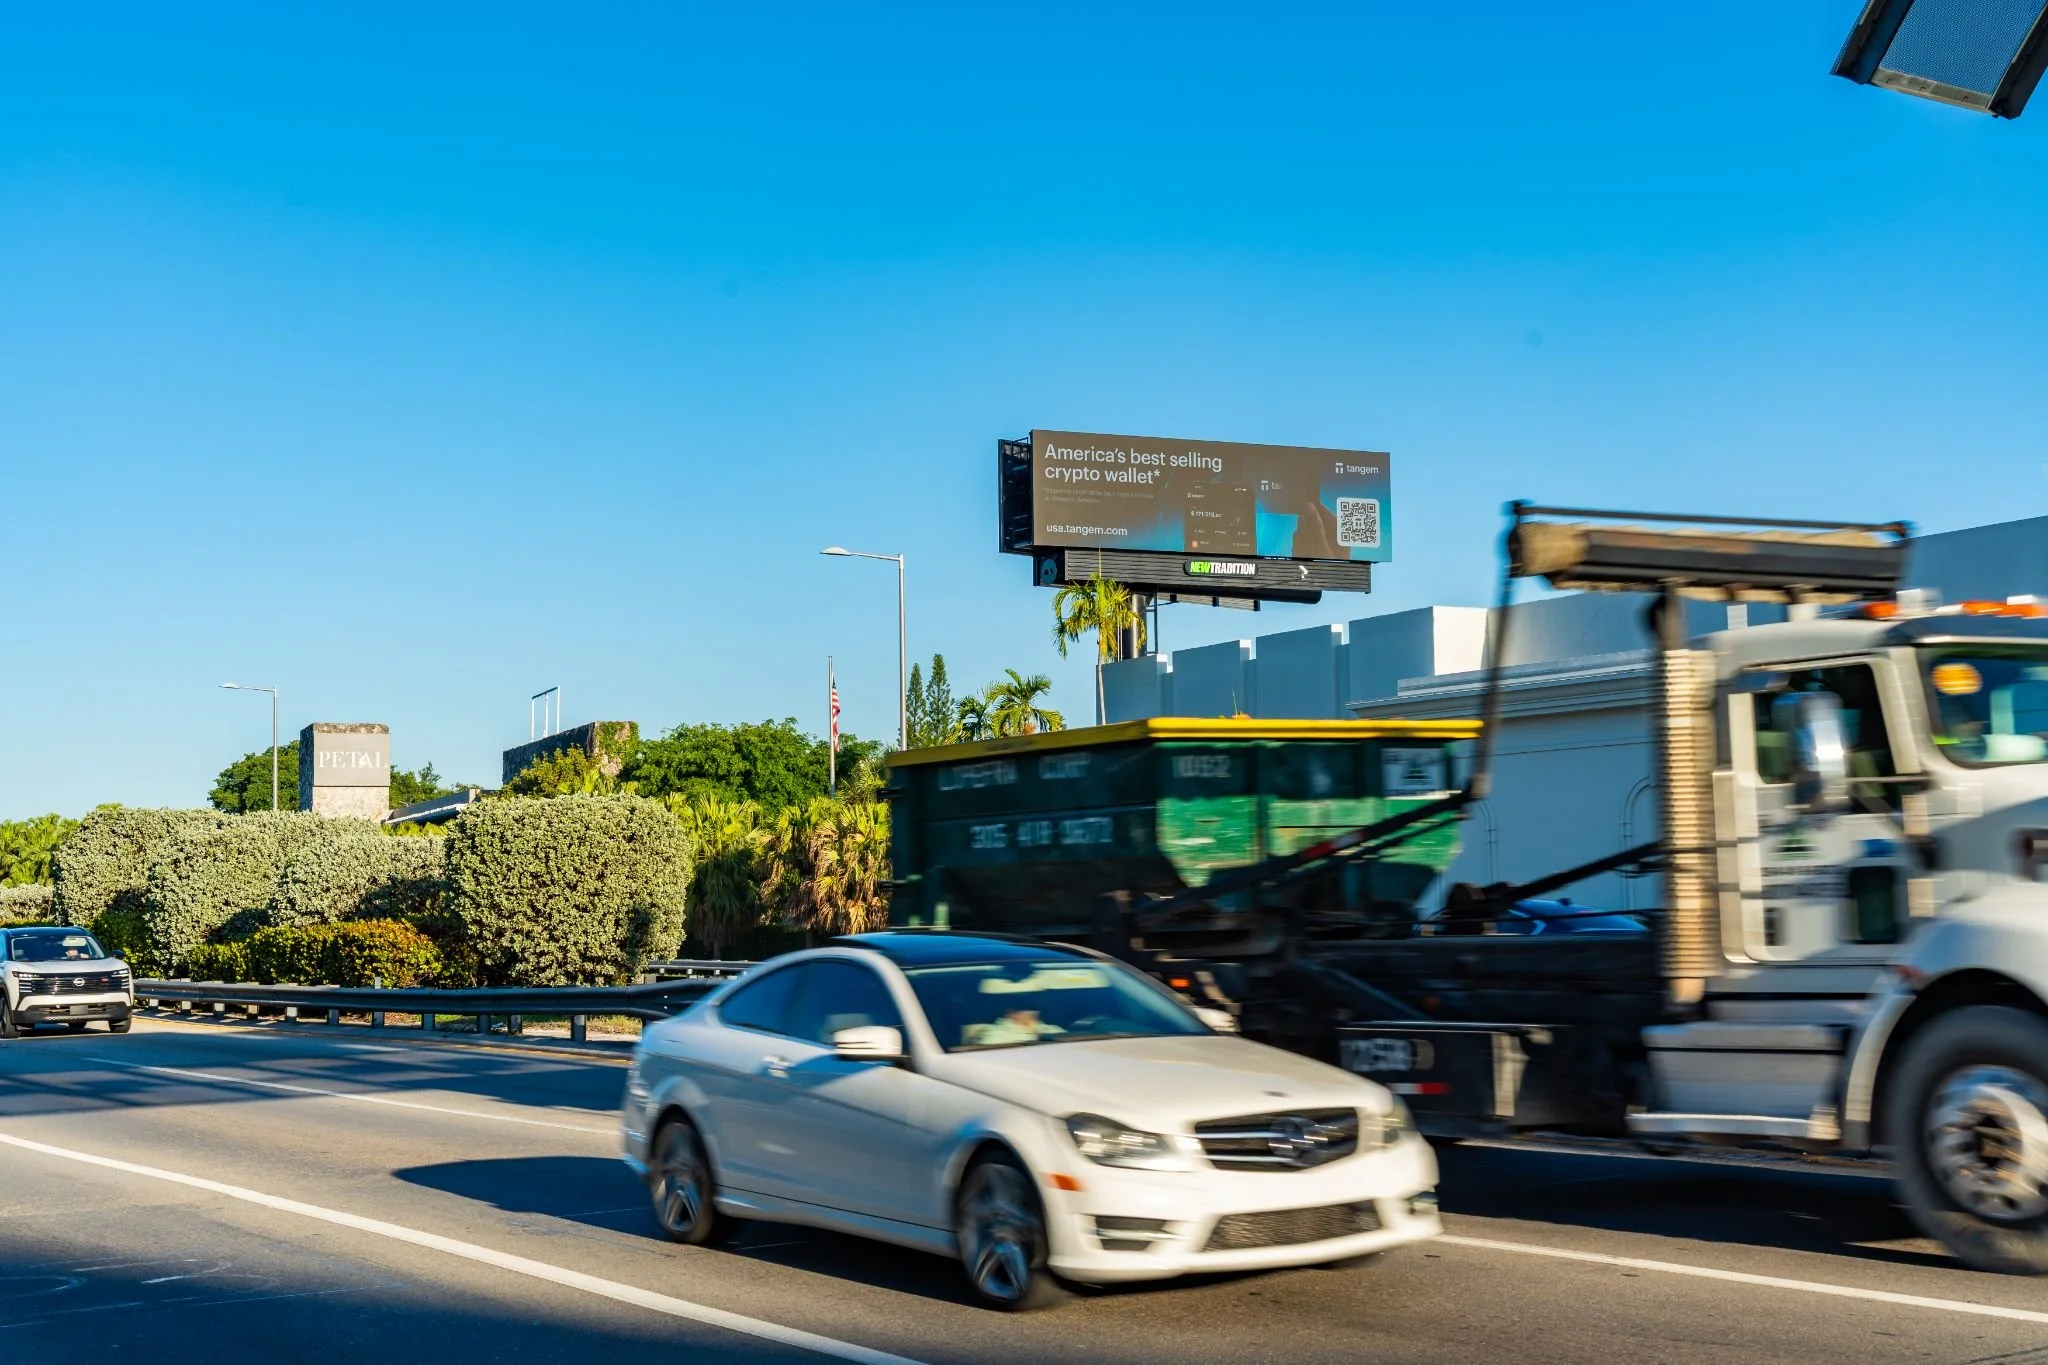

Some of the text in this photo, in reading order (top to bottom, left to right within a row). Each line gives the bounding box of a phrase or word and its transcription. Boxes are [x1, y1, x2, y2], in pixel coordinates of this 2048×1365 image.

[1044, 443, 1222, 473] America’s best selling
[1044, 465, 1100, 483] crypto
[1346, 464, 1379, 475] tangem
[1046, 523, 1128, 536] usa.tangem.com
[318, 751, 388, 769] PETAL
